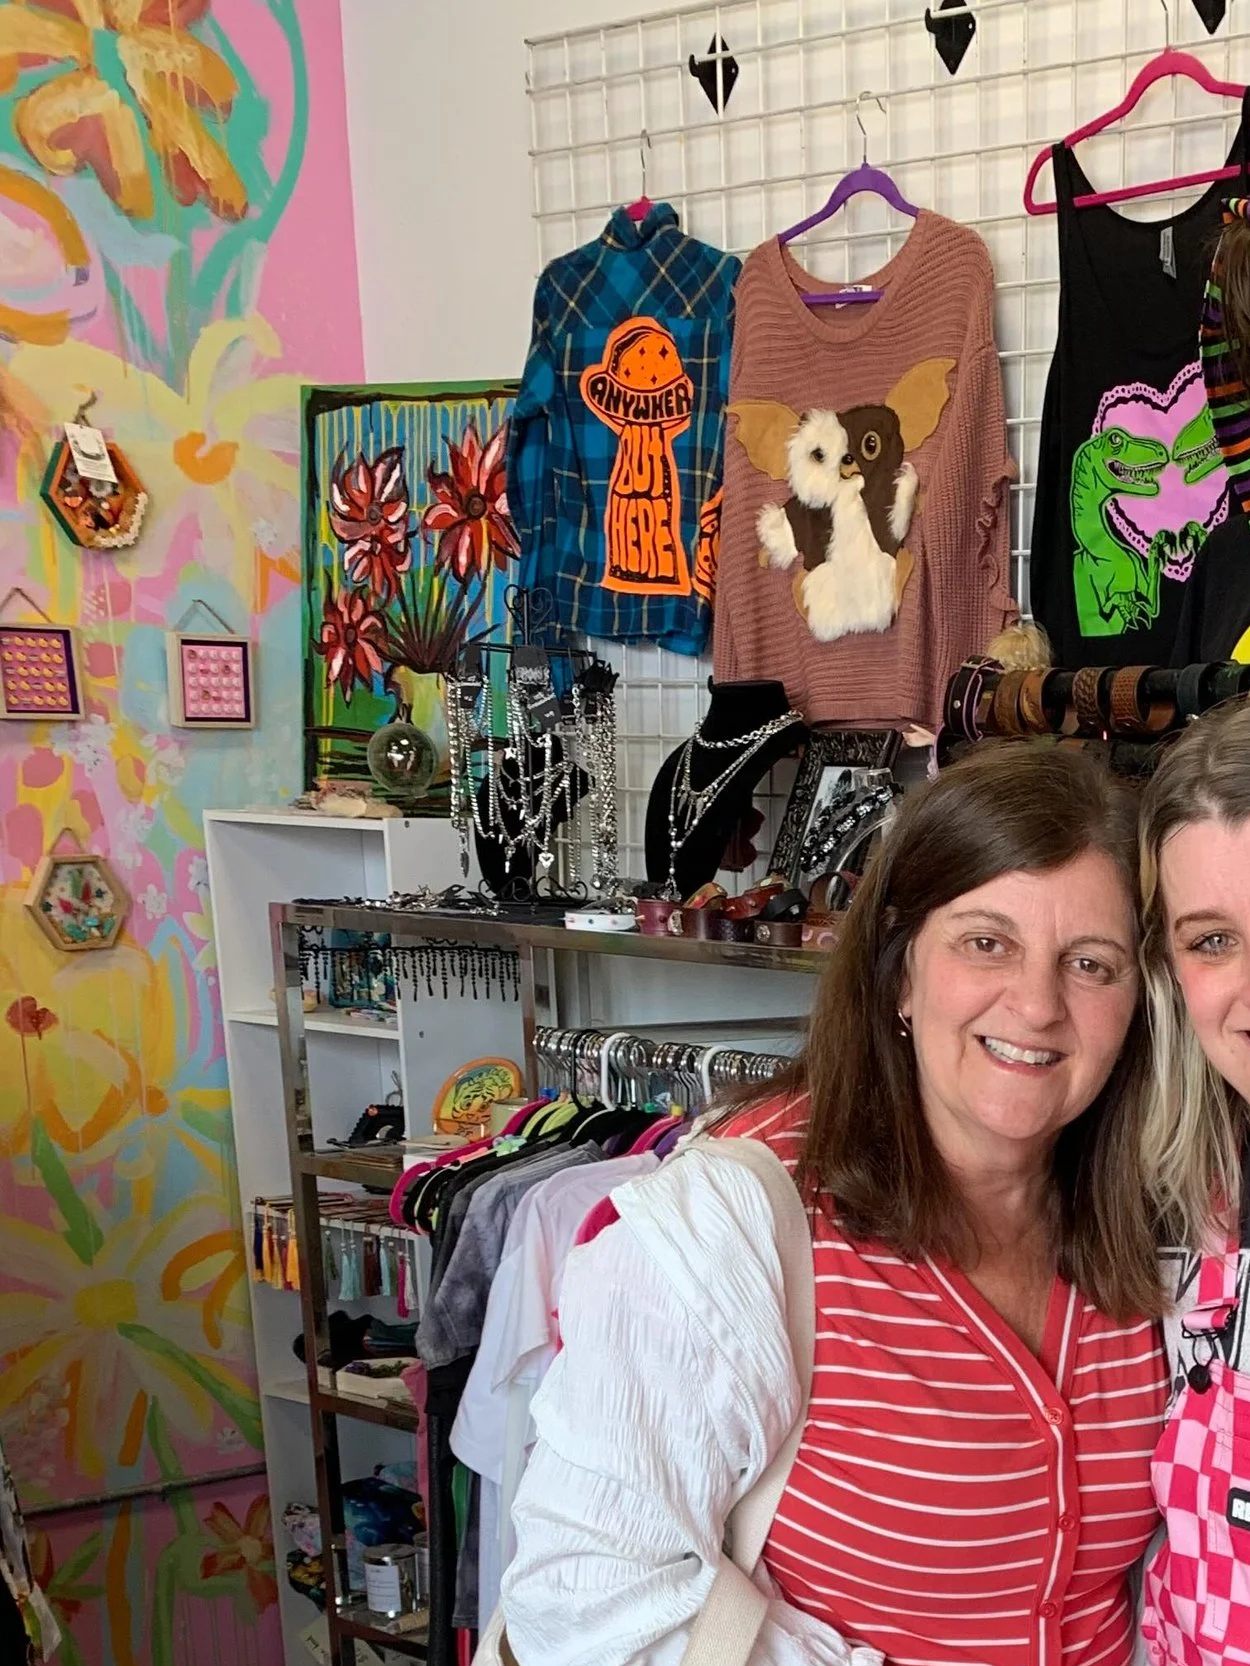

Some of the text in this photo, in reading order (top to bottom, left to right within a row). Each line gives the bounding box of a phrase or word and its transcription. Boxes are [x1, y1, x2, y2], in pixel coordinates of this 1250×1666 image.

[589, 376, 691, 420] ANYWHER
[614, 425, 664, 497] BUT
[613, 494, 674, 578] HERE
